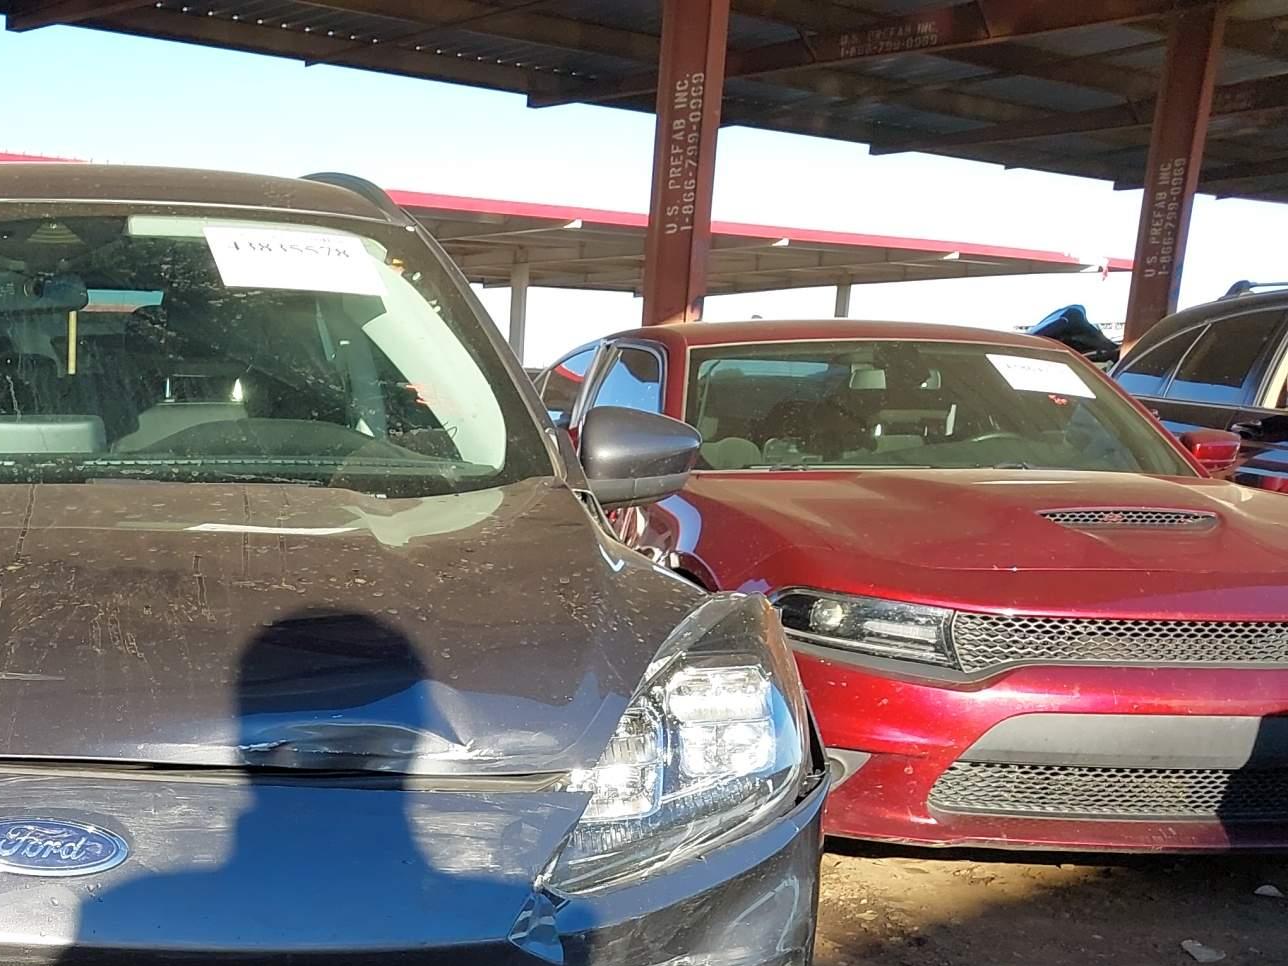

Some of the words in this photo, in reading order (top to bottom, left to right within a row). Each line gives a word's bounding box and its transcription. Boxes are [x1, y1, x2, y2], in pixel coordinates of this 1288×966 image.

[674, 73, 691, 108] INC.
[668, 118, 687, 190] PREFAB
[680, 72, 705, 231] 1-866-799-0969
[665, 200, 680, 235] U.S.
[1149, 191, 1168, 244] PREFAB
